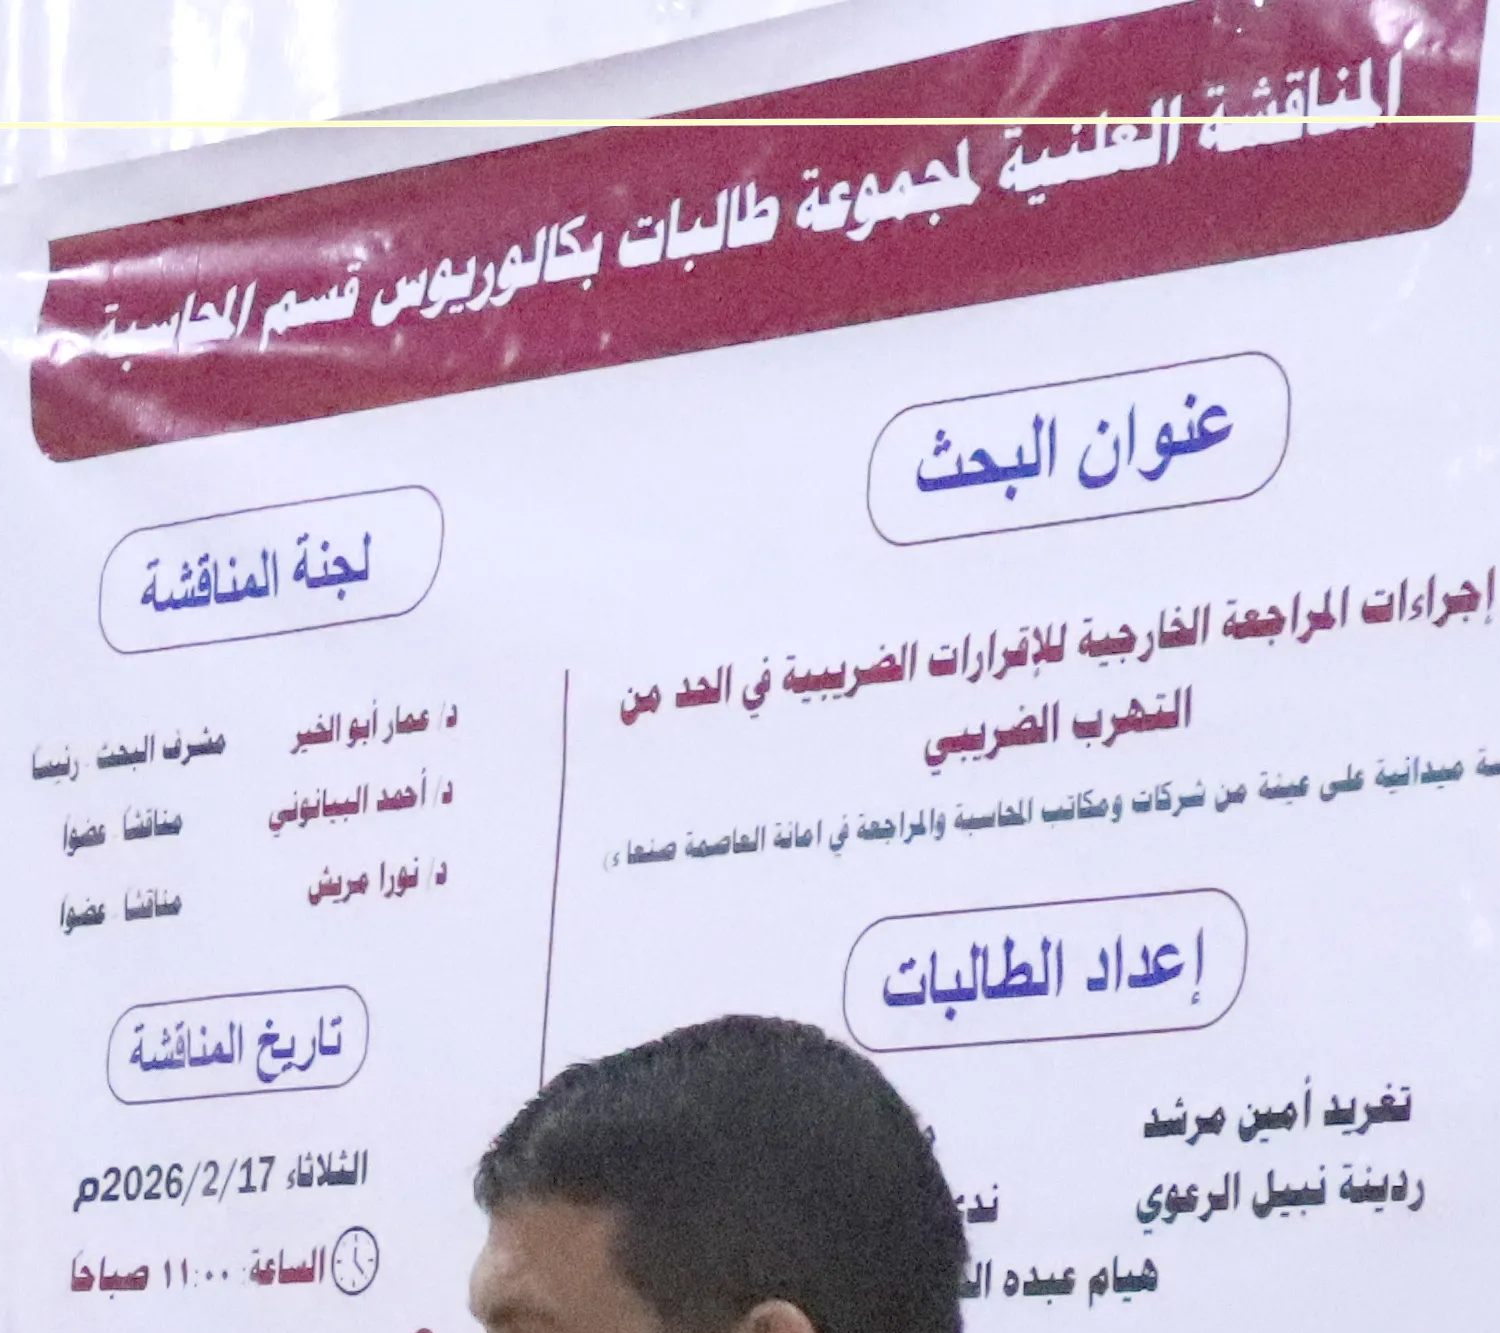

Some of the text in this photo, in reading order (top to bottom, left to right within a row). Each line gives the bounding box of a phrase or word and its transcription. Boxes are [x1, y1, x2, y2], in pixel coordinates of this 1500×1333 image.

[97, 53, 1403, 372] المناقشة العلنية لمجموعة طالبات بكالوريوس قسم المحاسبة
[916, 393, 1234, 500] عنوان البحث
[140, 531, 372, 613] لجنة المناقشة
[1222, 584, 1350, 645] المراجعة
[1361, 566, 1496, 628] إجراءات
[928, 621, 1067, 683] للإقرارات
[1078, 603, 1210, 667] الخارجية
[675, 663, 732, 709] الحد
[742, 657, 771, 719] في
[782, 640, 918, 703] الضريبية
[347, 698, 378, 749] أبو
[382, 702, 430, 744] عمار
[620, 683, 661, 725] من
[162, 726, 227, 765] مشرف
[289, 712, 341, 755] الخير
[924, 684, 1193, 776] التهرب الضريبي
[96, 733, 156, 772] البحث
[1375, 755, 1464, 794] ميدانية
[375, 768, 427, 811] أحمد
[1131, 779, 1206, 817] شركات
[1215, 782, 1247, 812] من
[1258, 771, 1309, 805] عينة
[1320, 763, 1364, 801] على
[268, 783, 368, 838] البيانوني
[857, 808, 946, 844] والمراجعة
[954, 797, 1032, 836] المحاسبة
[1040, 788, 1124, 828] ومكاتب
[684, 825, 766, 862] العاصمة
[773, 818, 822, 849] امانة
[829, 813, 850, 857] في
[307, 865, 369, 906] مريش
[380, 856, 419, 899] نورا
[882, 926, 1204, 1022] إعداد الطالبات
[129, 1014, 343, 1084] تاريخ المناقشة
[1143, 1075, 1412, 1144] تغريد أمين مرشد
[286, 1149, 369, 1189] الثلاثاء
[1339, 1162, 1425, 1212] ردينة
[1136, 1171, 1240, 1235] الرعوي
[1252, 1164, 1326, 1220] نبيل
[1003, 1266, 1076, 1306] عبده
[1088, 1255, 1159, 1308] هيام
